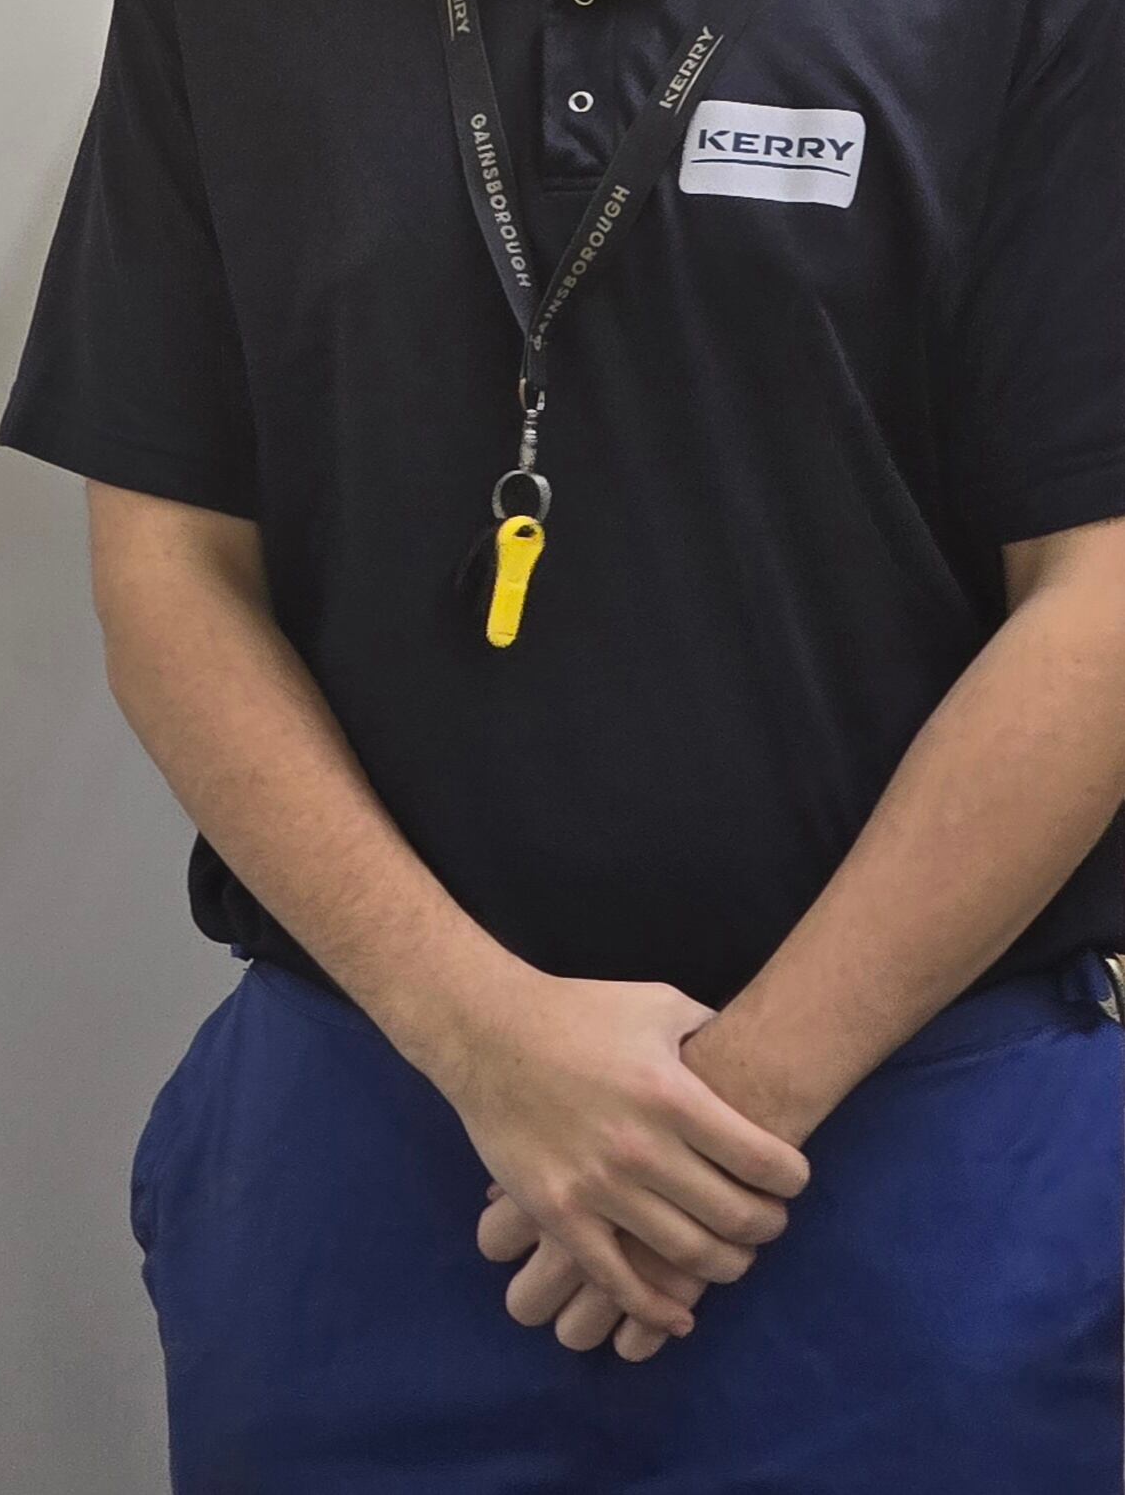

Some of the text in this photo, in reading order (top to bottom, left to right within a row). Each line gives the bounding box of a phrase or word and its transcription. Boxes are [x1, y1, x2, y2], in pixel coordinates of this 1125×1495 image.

[659, 25, 716, 109] KERRY
[698, 129, 855, 162] KERRY
[470, 113, 531, 288] GAINSBOROUGH
